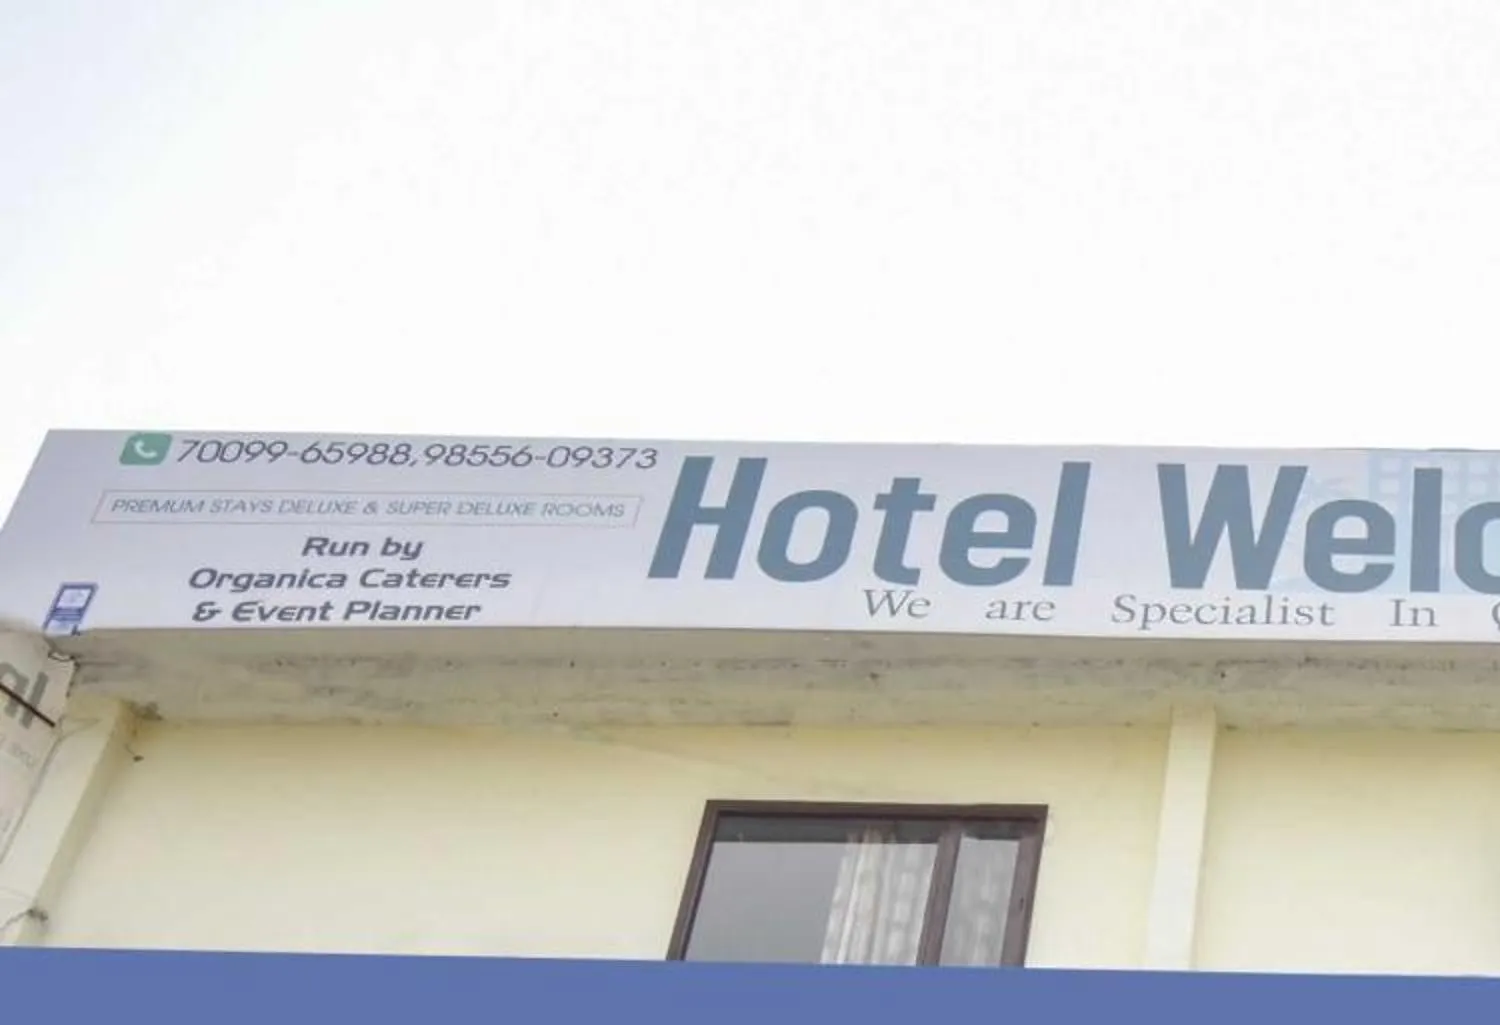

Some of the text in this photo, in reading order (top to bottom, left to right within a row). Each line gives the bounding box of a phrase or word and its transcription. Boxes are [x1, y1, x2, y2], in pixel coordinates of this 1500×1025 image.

[209, 499, 273, 514] STAYS
[278, 499, 357, 515] DELUXE
[385, 500, 451, 516] SUPER
[456, 500, 537, 517] DELUXE
[540, 502, 625, 518] ROOMS
[647, 455, 1091, 587] Hotel
[301, 536, 425, 561] Run by
[188, 567, 513, 593] Organica Caterers
[191, 601, 482, 622] & Event Planner
[864, 588, 931, 619] We
[985, 598, 1056, 621] are
[1111, 594, 1335, 630] Specialist
[1388, 599, 1438, 628] In
